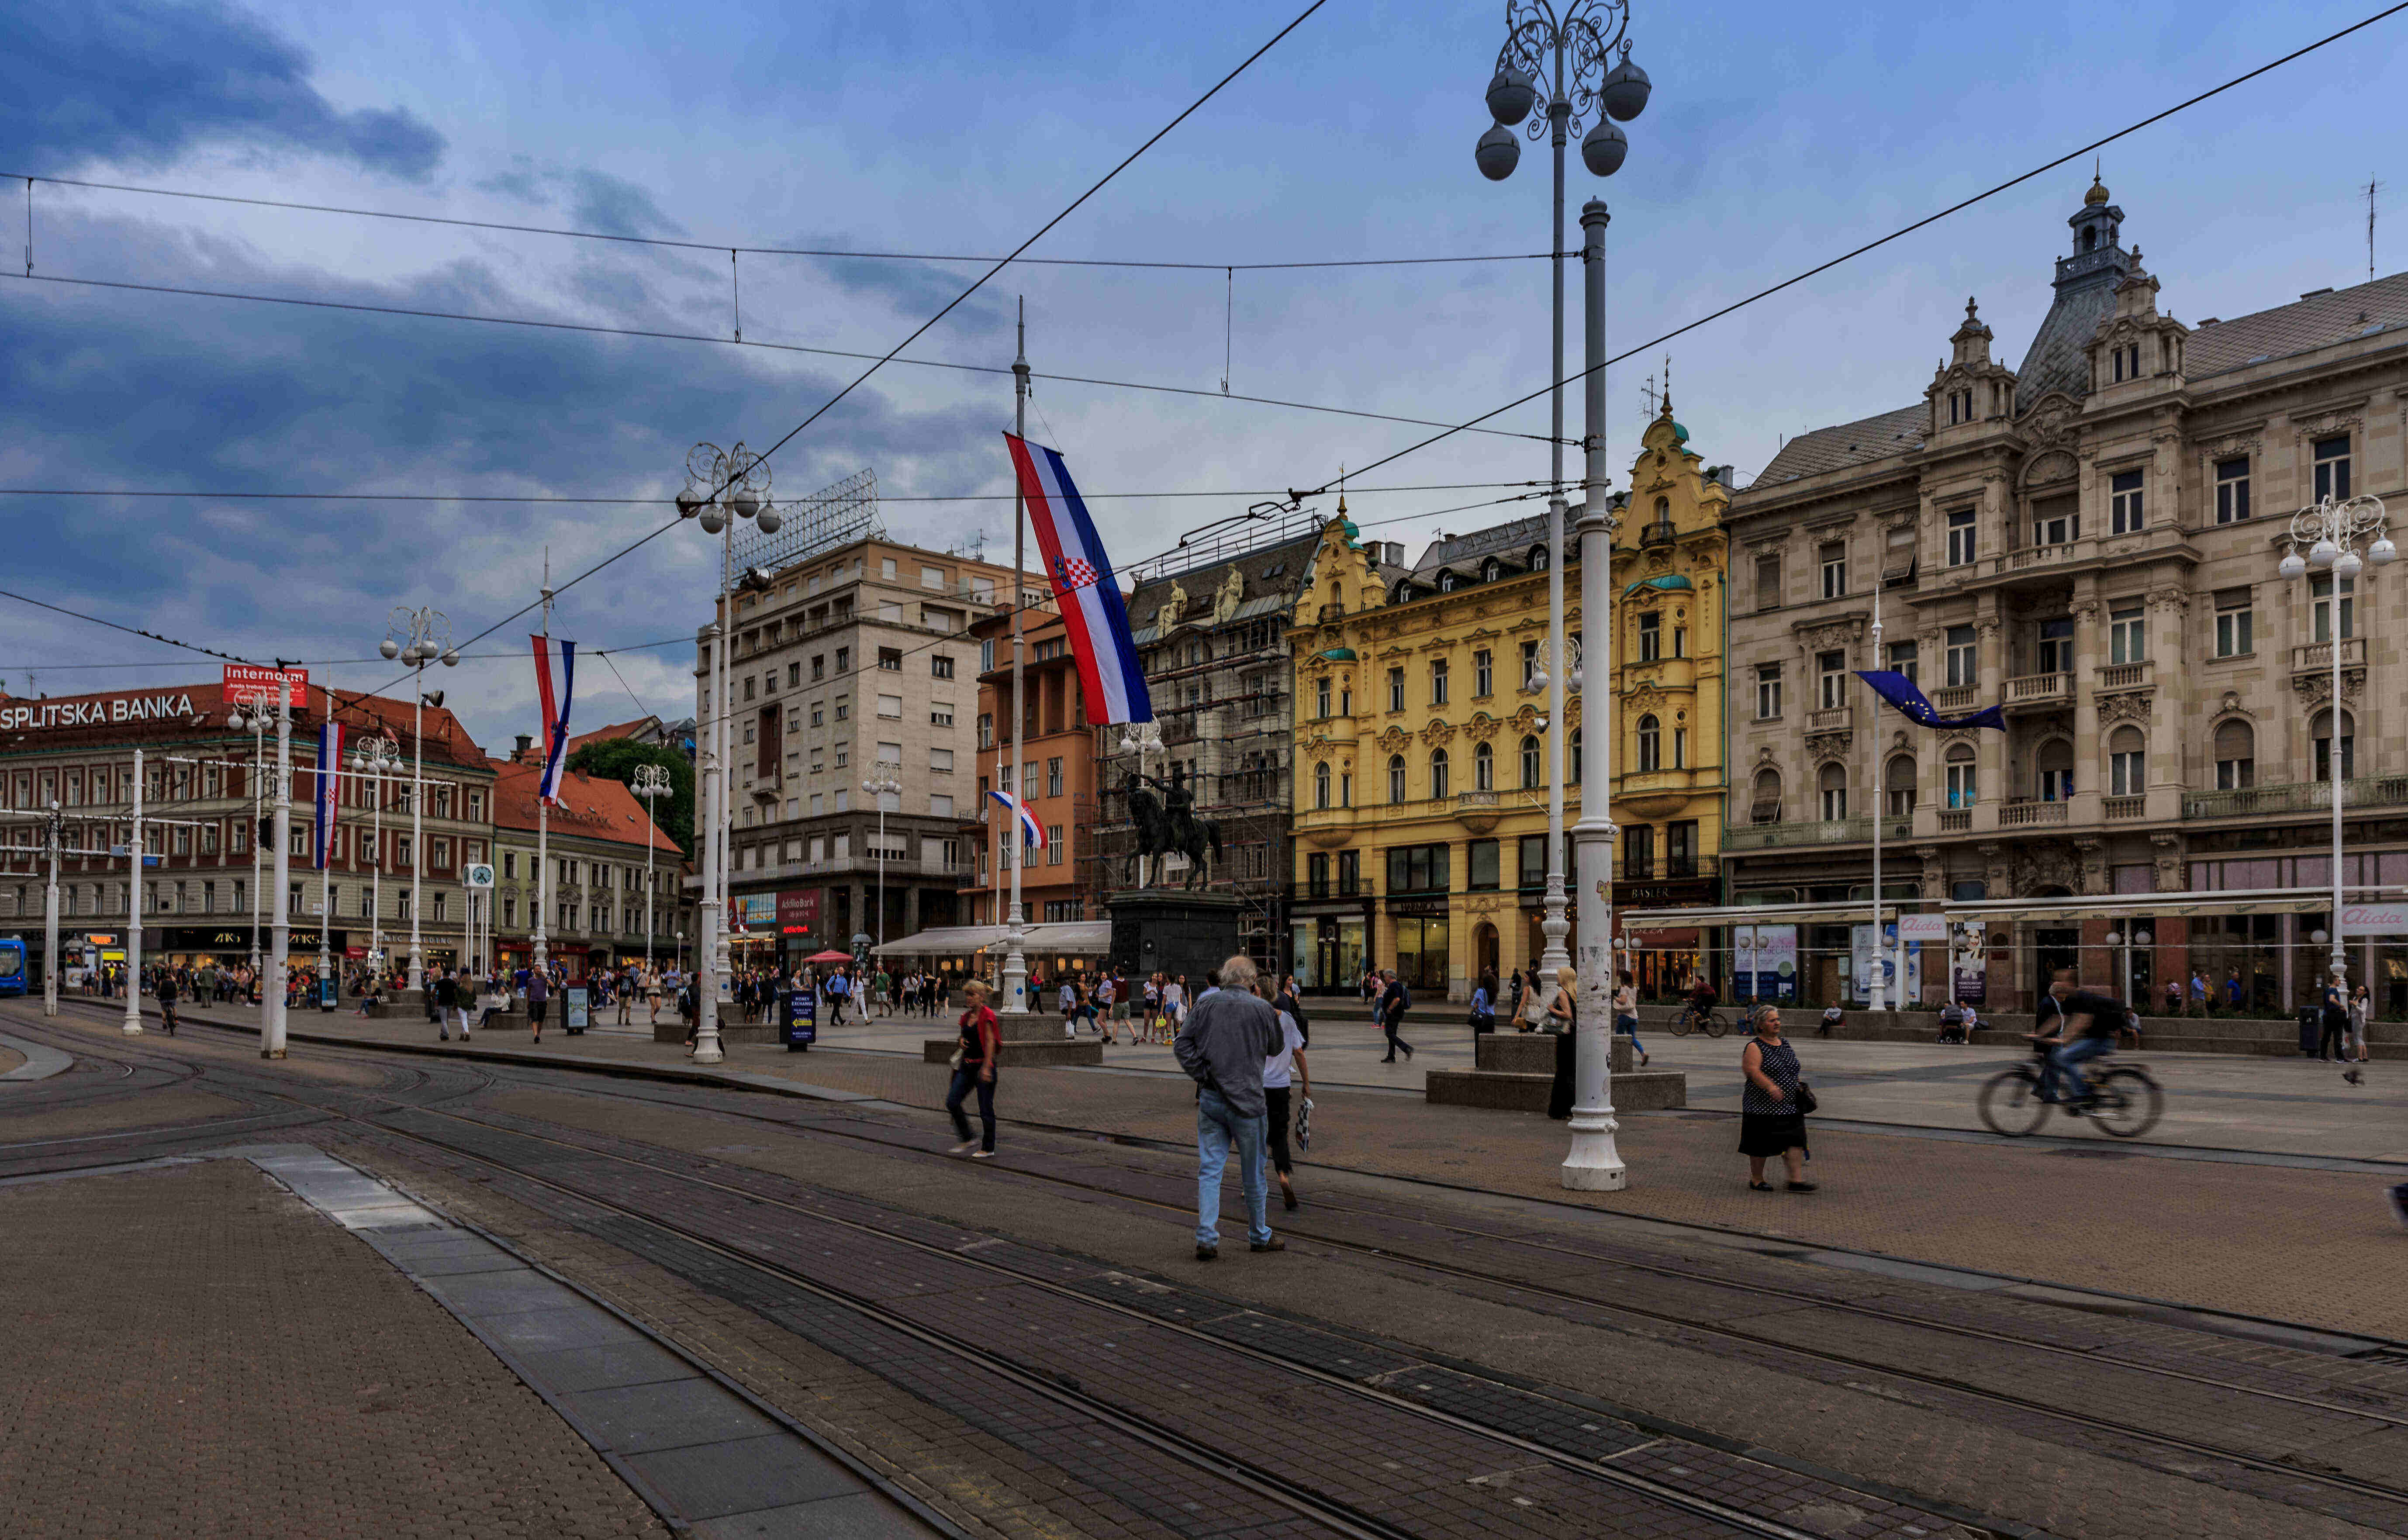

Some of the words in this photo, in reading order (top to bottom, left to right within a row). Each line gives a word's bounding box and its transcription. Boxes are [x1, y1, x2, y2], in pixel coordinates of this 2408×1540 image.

[227, 666, 304, 682] Internorm
[0, 701, 107, 730] SPLITSKA
[112, 693, 194, 722] BANKA
[1632, 887, 1669, 898] BASLER
[799, 896, 814, 908] Bank
[1901, 917, 1943, 932] Aida
